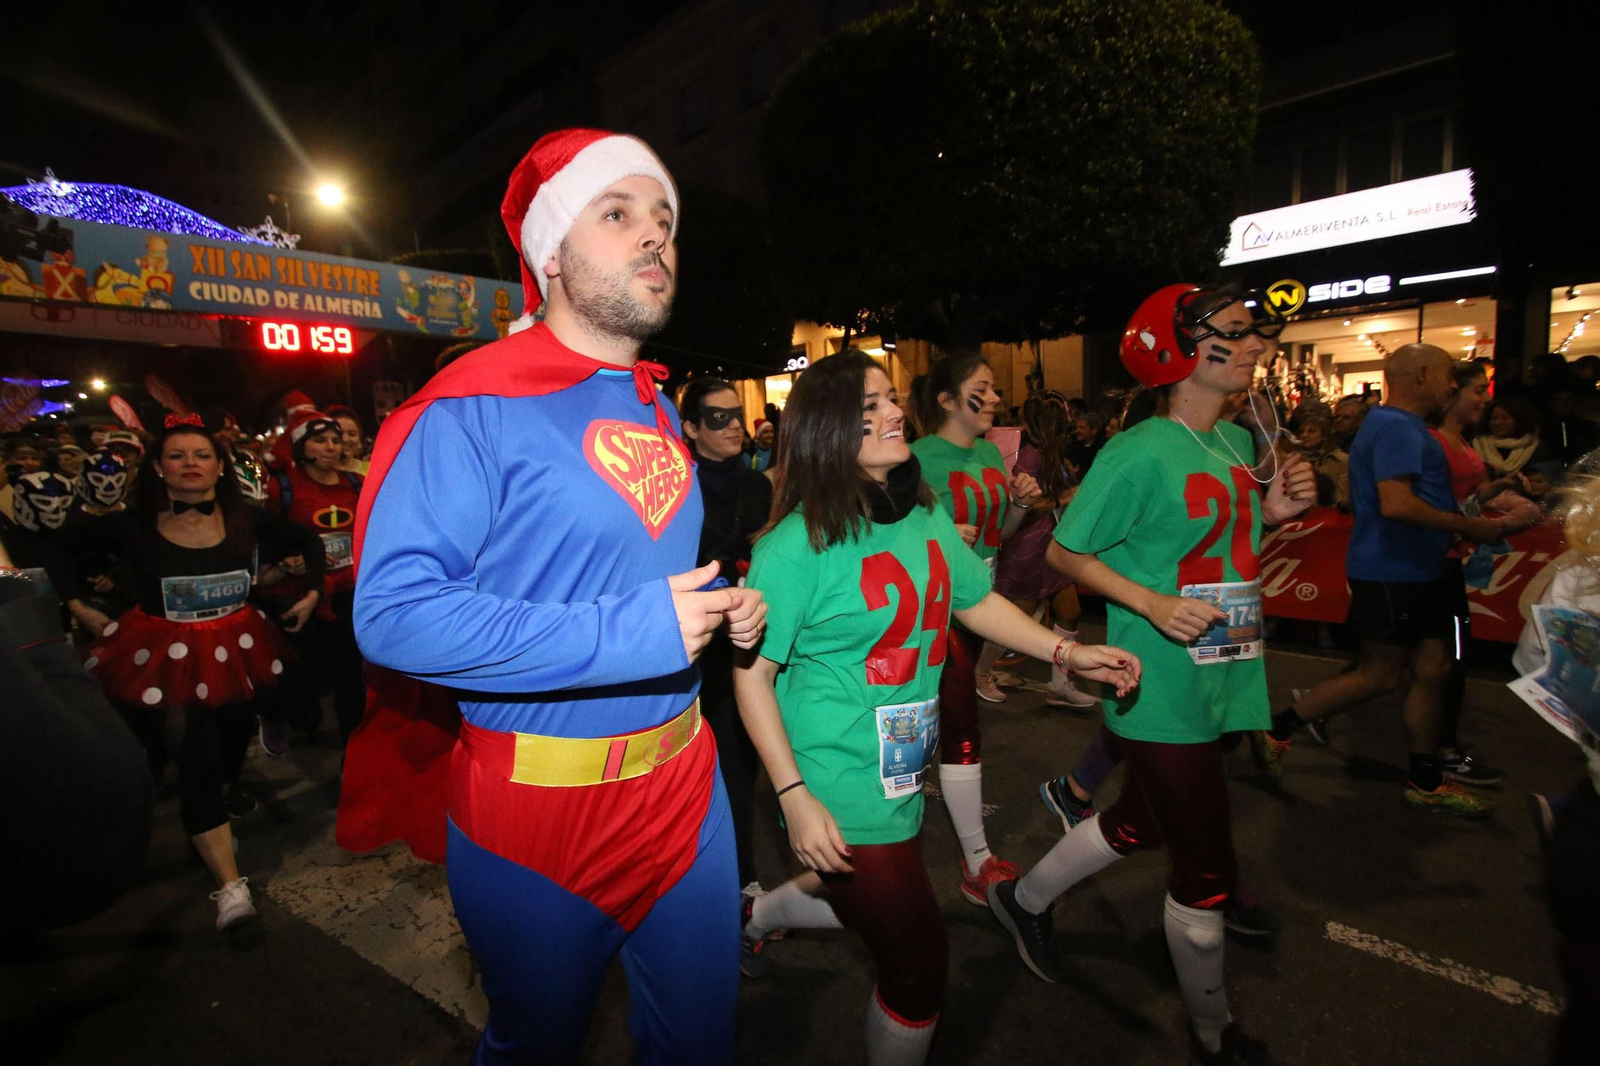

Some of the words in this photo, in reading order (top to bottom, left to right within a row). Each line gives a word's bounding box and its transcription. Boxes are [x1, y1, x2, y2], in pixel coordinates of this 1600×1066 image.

[1274, 213, 1370, 242] ALMERIVENTA
[1407, 206, 1431, 217] Real
[188, 244, 226, 278] XII
[230, 249, 272, 283] SAN
[275, 256, 381, 296] SILVESTRE
[188, 281, 270, 307] CIUDAD
[274, 290, 299, 309] DE
[304, 294, 382, 319] ALMERÍA
[598, 424, 678, 487] SUPER
[641, 468, 685, 526] HERO
[200, 582, 245, 602] 1460
[859, 539, 951, 686] 24
[1226, 603, 1262, 627] 174
